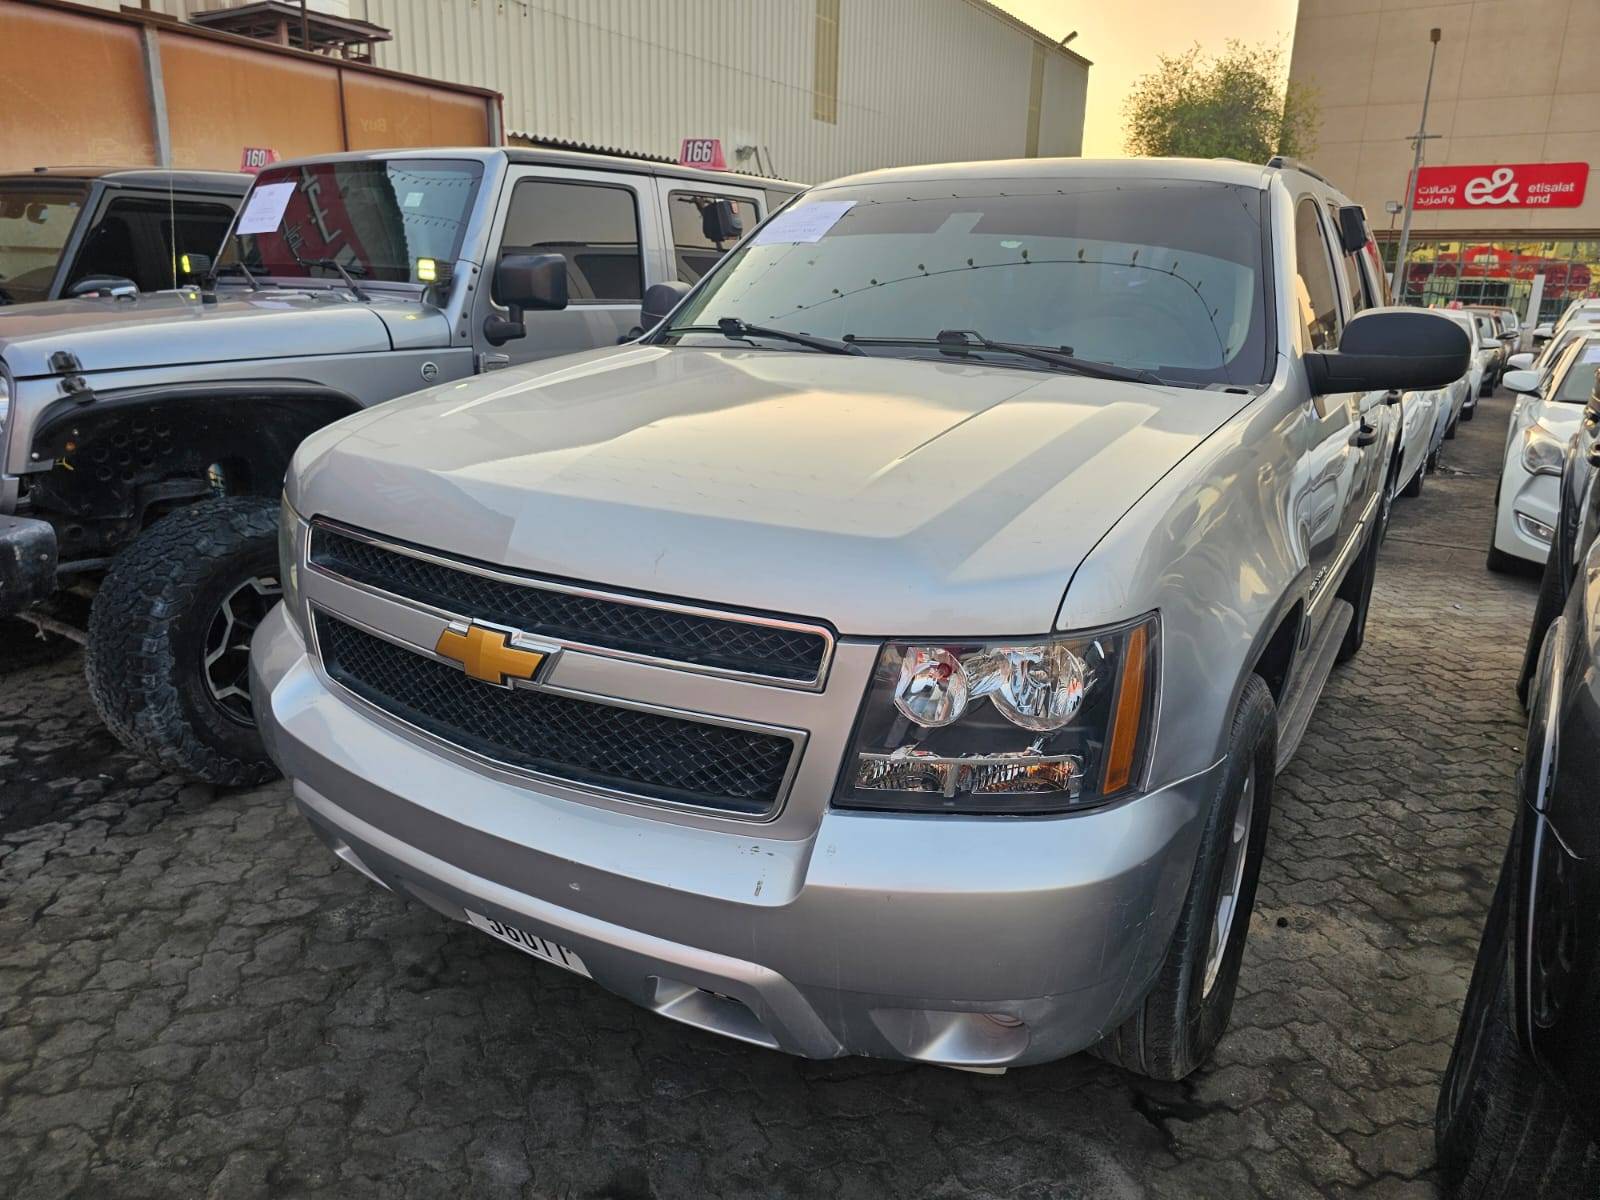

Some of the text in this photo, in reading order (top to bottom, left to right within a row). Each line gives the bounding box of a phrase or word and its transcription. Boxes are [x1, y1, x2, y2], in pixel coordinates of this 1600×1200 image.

[686, 141, 712, 163] 166
[246, 150, 266, 167] 160
[1418, 184, 1456, 195] اتصالات
[1464, 167, 1520, 205] e&
[1528, 182, 1575, 194] etisalat
[1417, 195, 1455, 206] والمزيد
[1526, 194, 1551, 204] and
